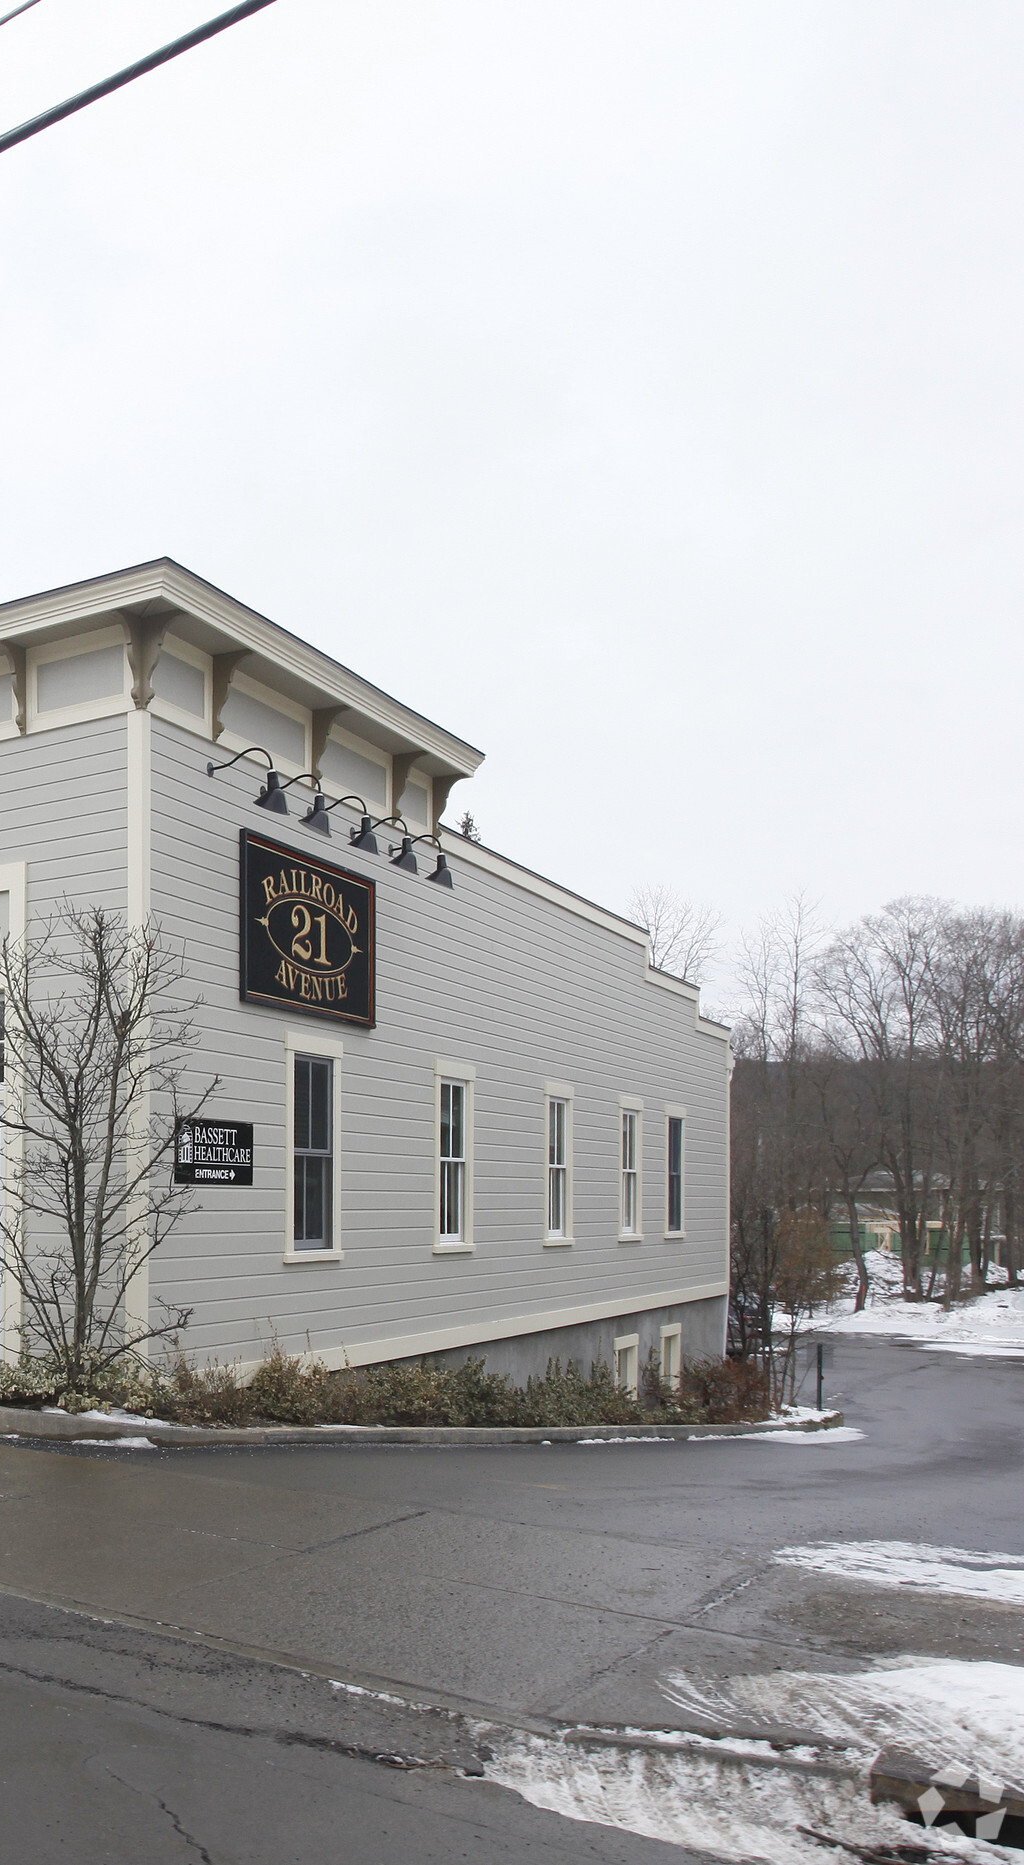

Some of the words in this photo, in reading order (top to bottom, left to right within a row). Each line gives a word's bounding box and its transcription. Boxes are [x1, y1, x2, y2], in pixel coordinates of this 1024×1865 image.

[261, 868, 359, 935] RAILROAD
[290, 903, 333, 967] 21
[274, 958, 348, 1001] AVENUE
[194, 1126, 238, 1146] BASSETT
[193, 1145, 251, 1163] HEALTHCARE
[194, 1168, 229, 1180] ENTRANCE
